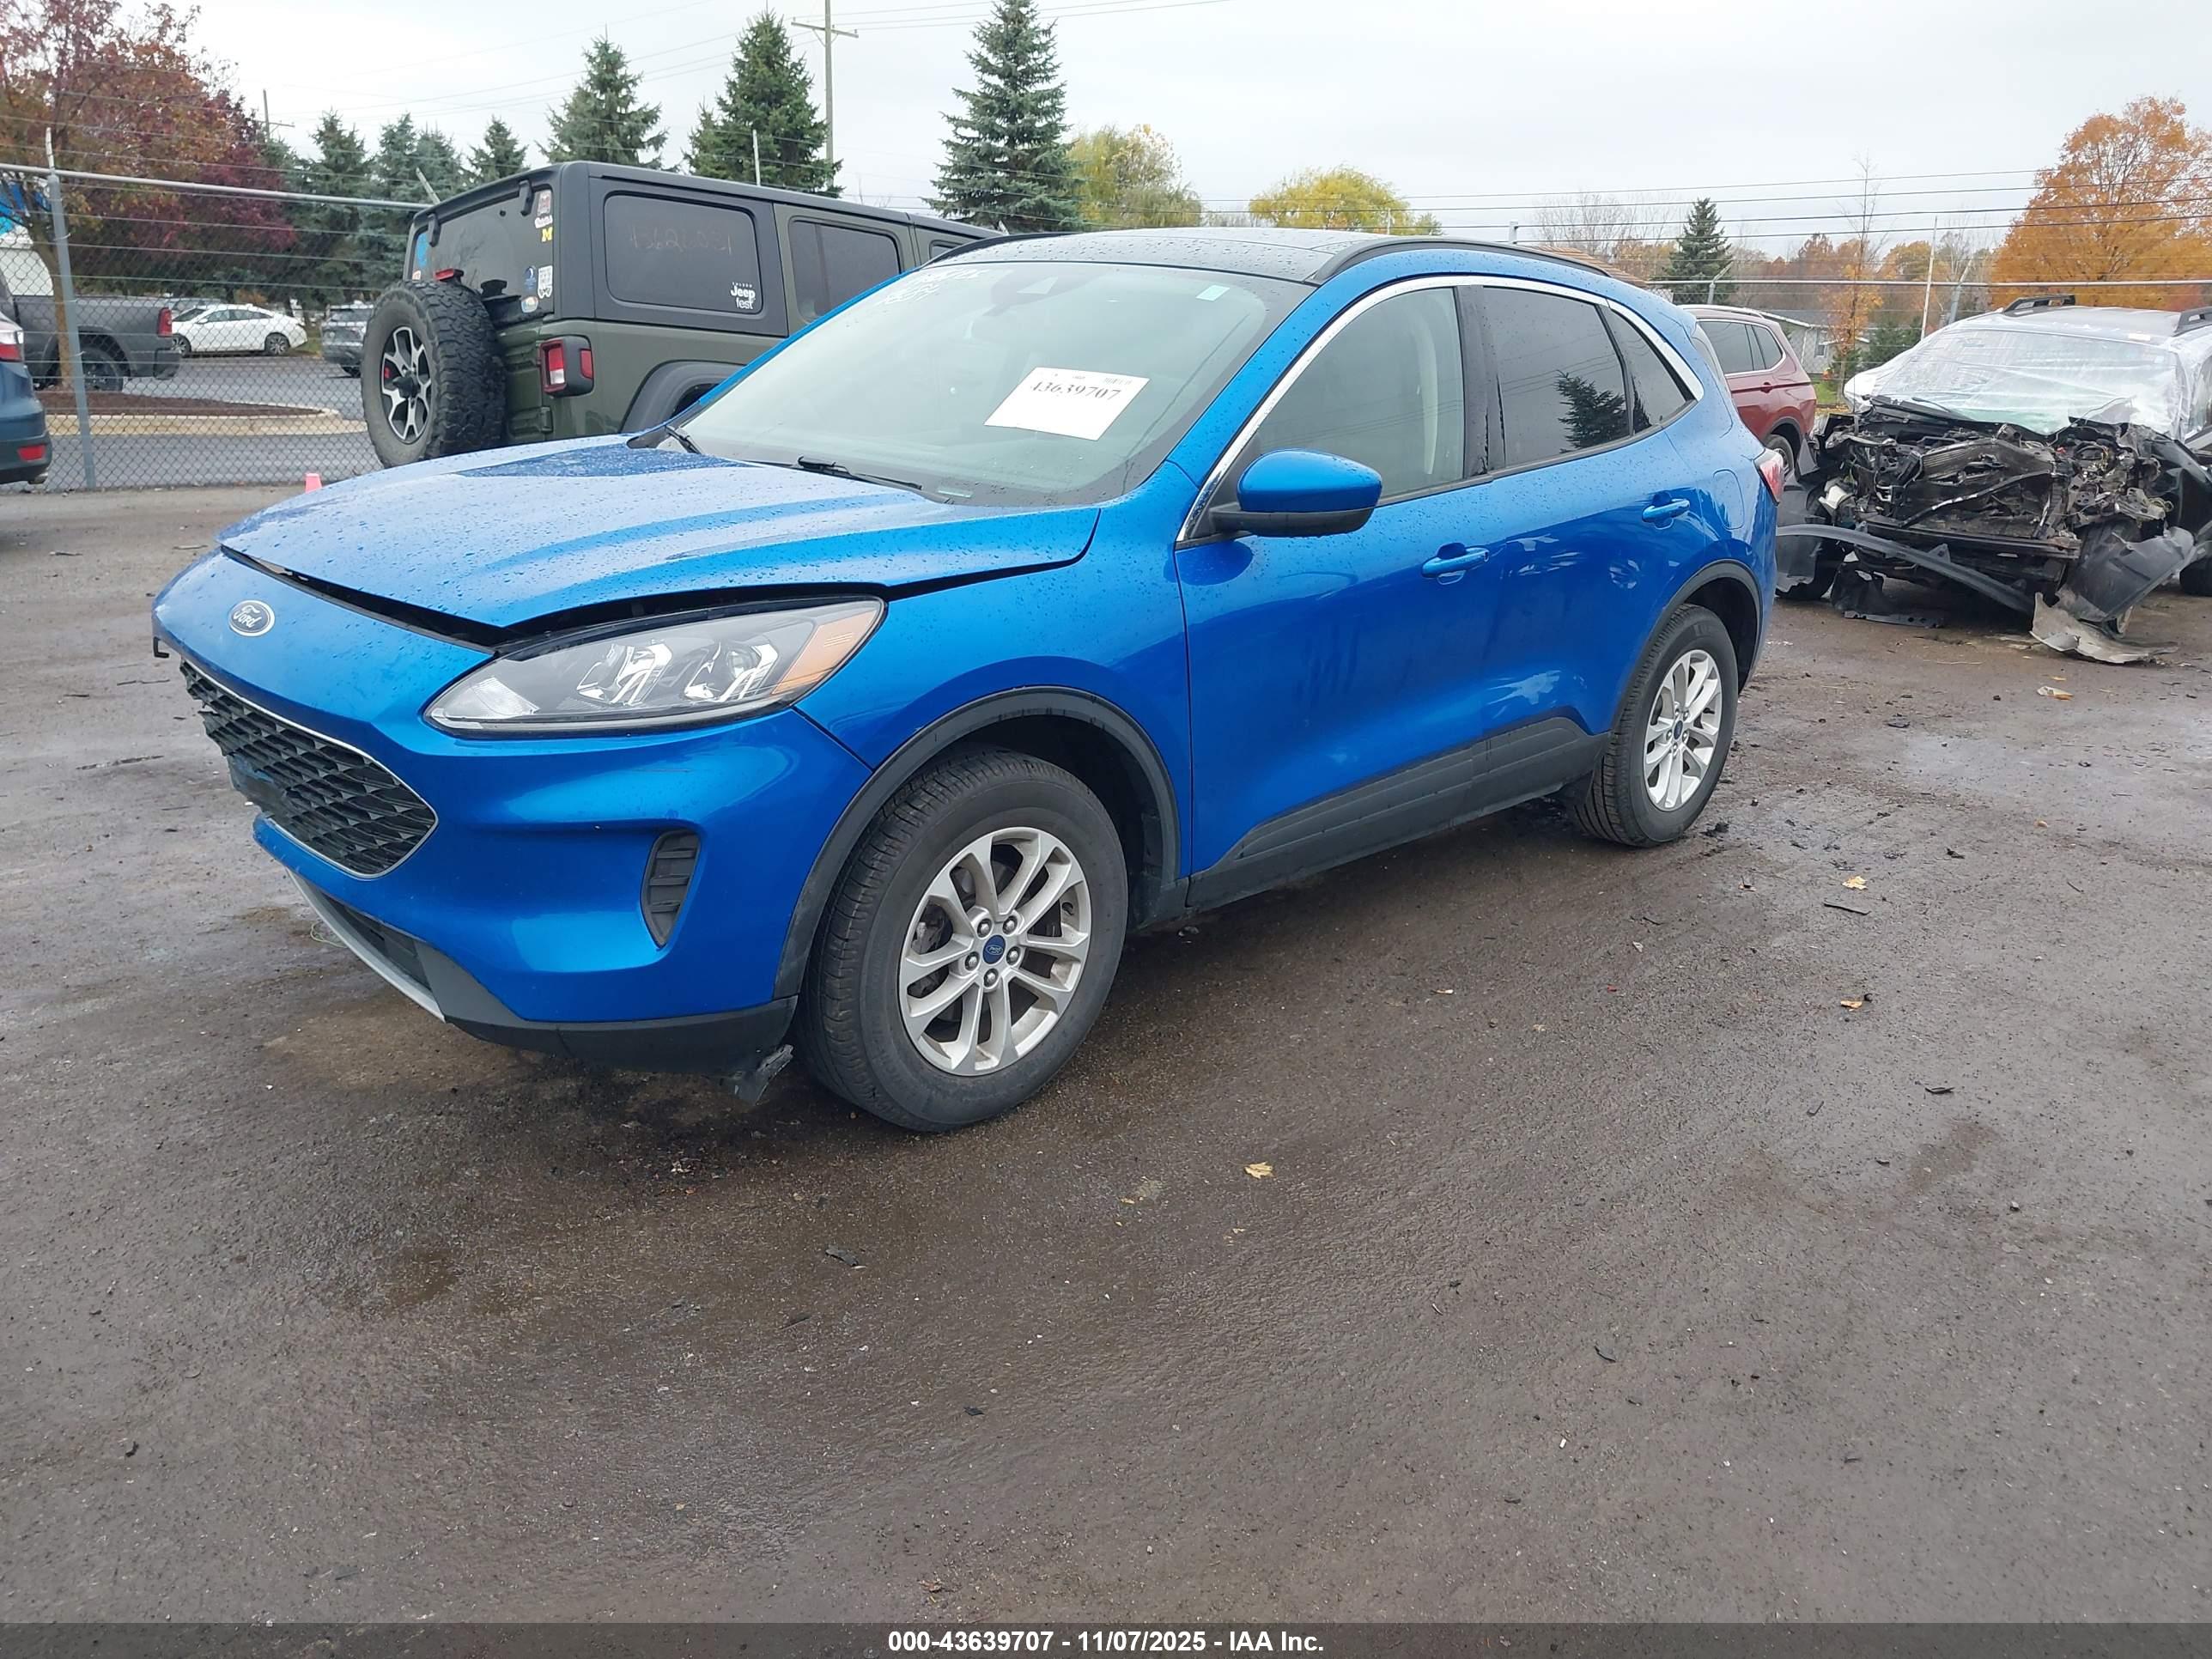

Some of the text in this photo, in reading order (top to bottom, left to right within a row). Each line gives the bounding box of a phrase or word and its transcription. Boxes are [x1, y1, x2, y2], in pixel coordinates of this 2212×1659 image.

[542, 227, 554, 242] M
[730, 285, 756, 301] Jeep
[736, 296, 754, 310] fest
[233, 605, 263, 628] Ford
